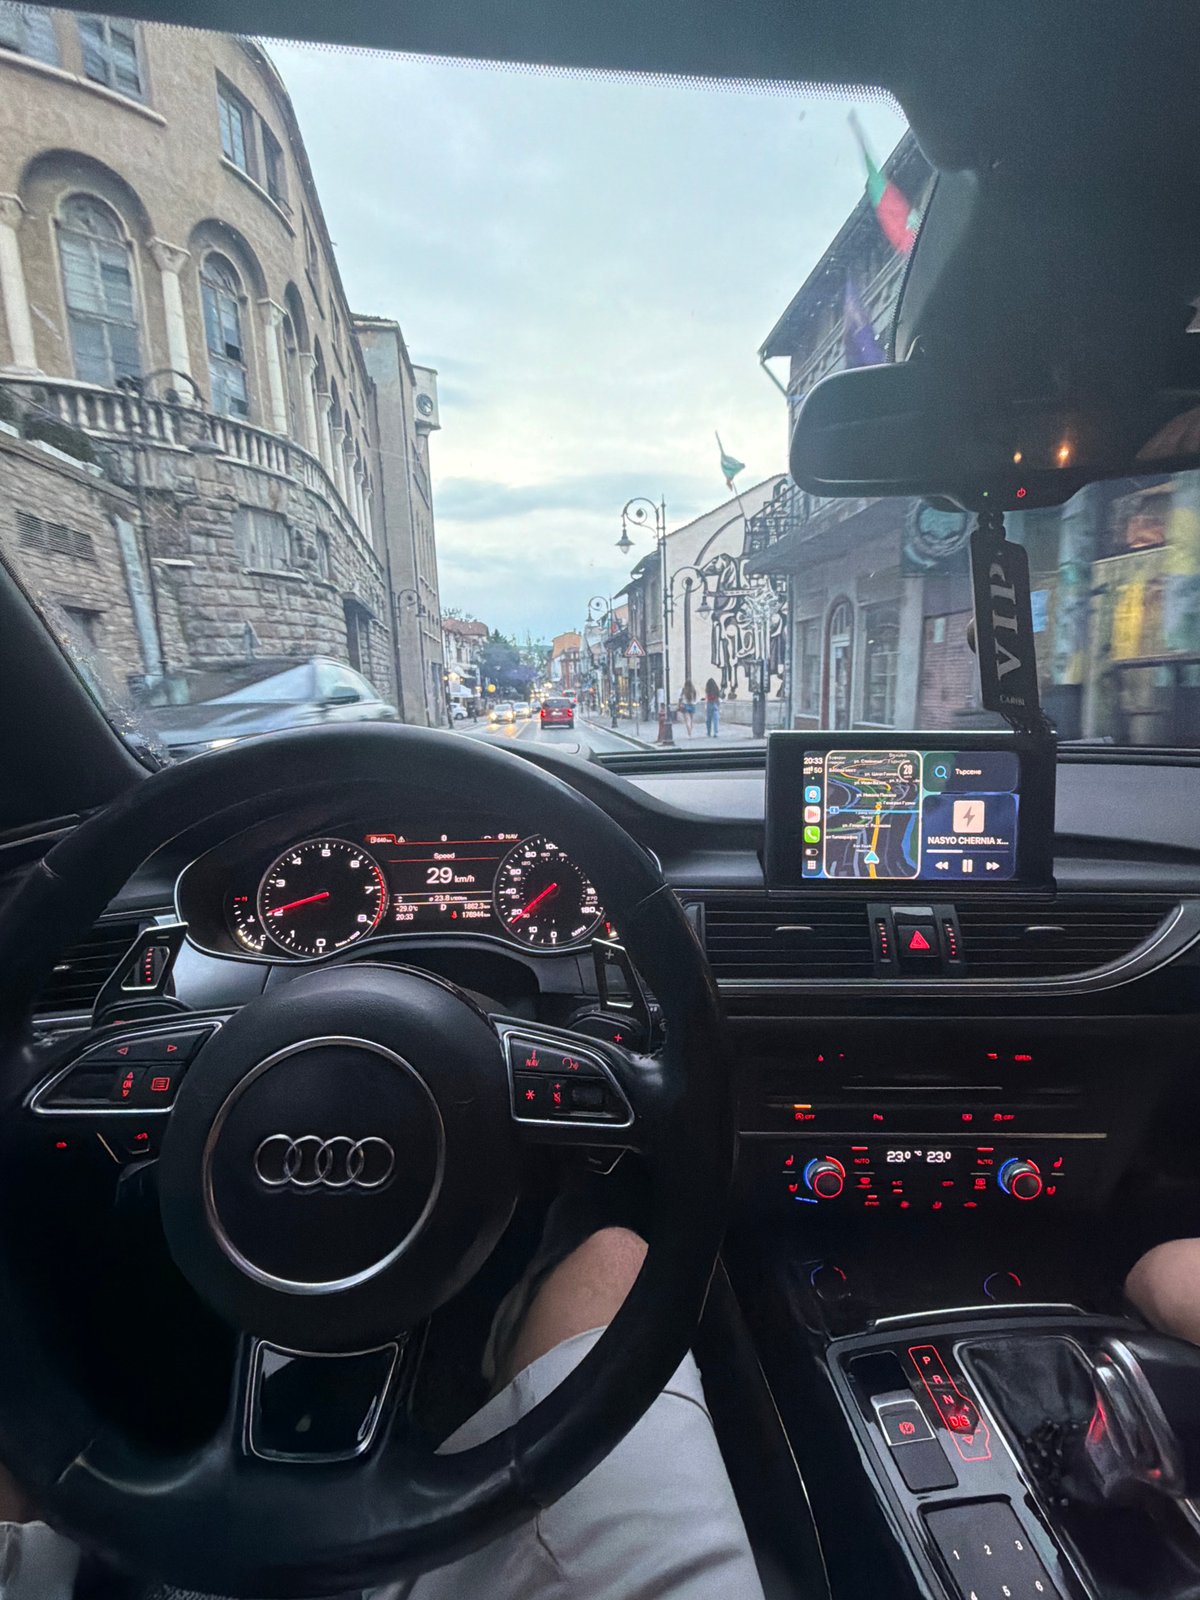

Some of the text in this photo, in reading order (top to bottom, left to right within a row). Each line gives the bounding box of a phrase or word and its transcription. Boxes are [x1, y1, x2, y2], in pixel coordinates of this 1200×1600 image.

[989, 563, 1021, 680] VIP
[803, 757, 823, 765] 20:33
[928, 837, 956, 845] NASYO
[958, 837, 995, 845] CHERNIA
[321, 849, 331, 857] 5
[434, 852, 456, 860] Speed
[292, 857, 302, 865] 4
[426, 867, 475, 884] 29 km/h
[275, 879, 286, 887] 3
[364, 886, 374, 894] 7
[505, 887, 517, 895] 40
[274, 908, 284, 917] 2
[511, 908, 523, 916] 20
[396, 913, 414, 921] 20:33
[290, 930, 295, 938] 1
[528, 926, 538, 934] 10
[316, 938, 326, 947] 0
[887, 1150, 912, 1163] 23.0
[926, 1150, 951, 1163] 23.0
[922, 1356, 931, 1365] P
[932, 1375, 943, 1385] R
[942, 1394, 955, 1405] N
[947, 1415, 971, 1429] D/S
[983, 1544, 993, 1555] 2
[1014, 1540, 1024, 1551] 3
[953, 1550, 960, 1560] 1
[1035, 1580, 1044, 1592] 6
[970, 1590, 979, 1600] 4
[1002, 1585, 1012, 1597] 5
